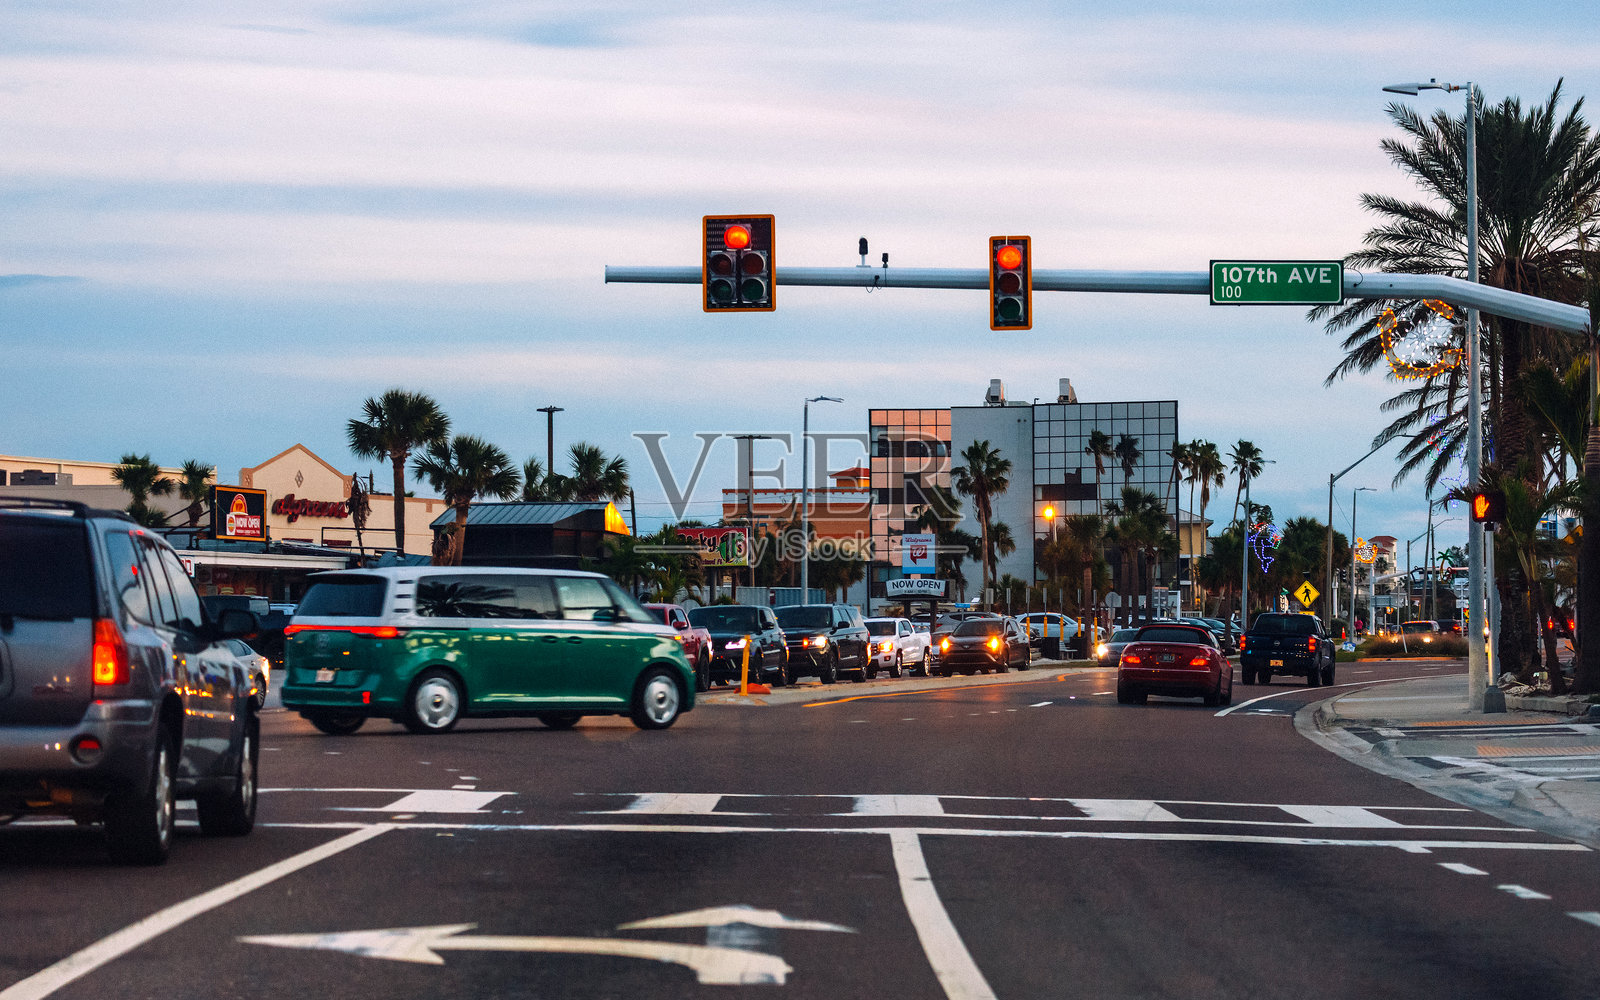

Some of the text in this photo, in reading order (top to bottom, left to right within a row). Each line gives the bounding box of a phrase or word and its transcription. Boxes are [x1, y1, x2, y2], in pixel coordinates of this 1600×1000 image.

[1221, 267, 1332, 284] 107th AVE
[1221, 285, 1242, 298] 100
[247, 517, 260, 529] OPEN
[892, 580, 941, 590] NOW OPEN
